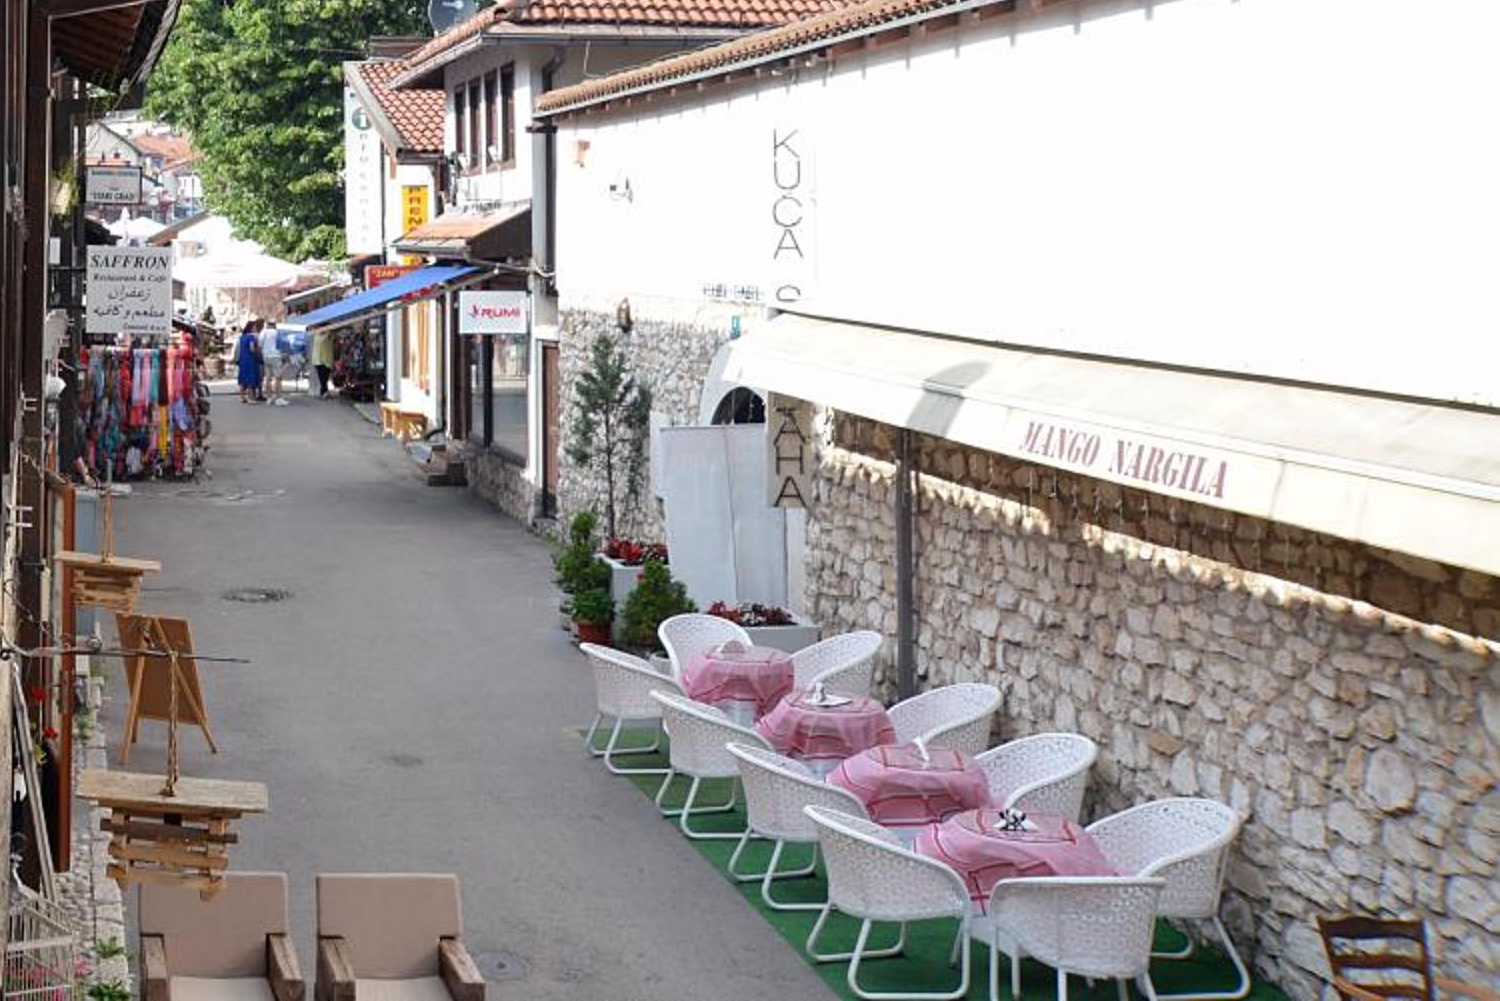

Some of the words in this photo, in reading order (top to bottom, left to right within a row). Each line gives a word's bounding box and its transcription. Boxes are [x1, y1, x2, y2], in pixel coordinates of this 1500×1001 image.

[90, 254, 169, 268] SAFFRON
[1021, 421, 1101, 468] MANGO
[1107, 439, 1228, 499] NARGILA
